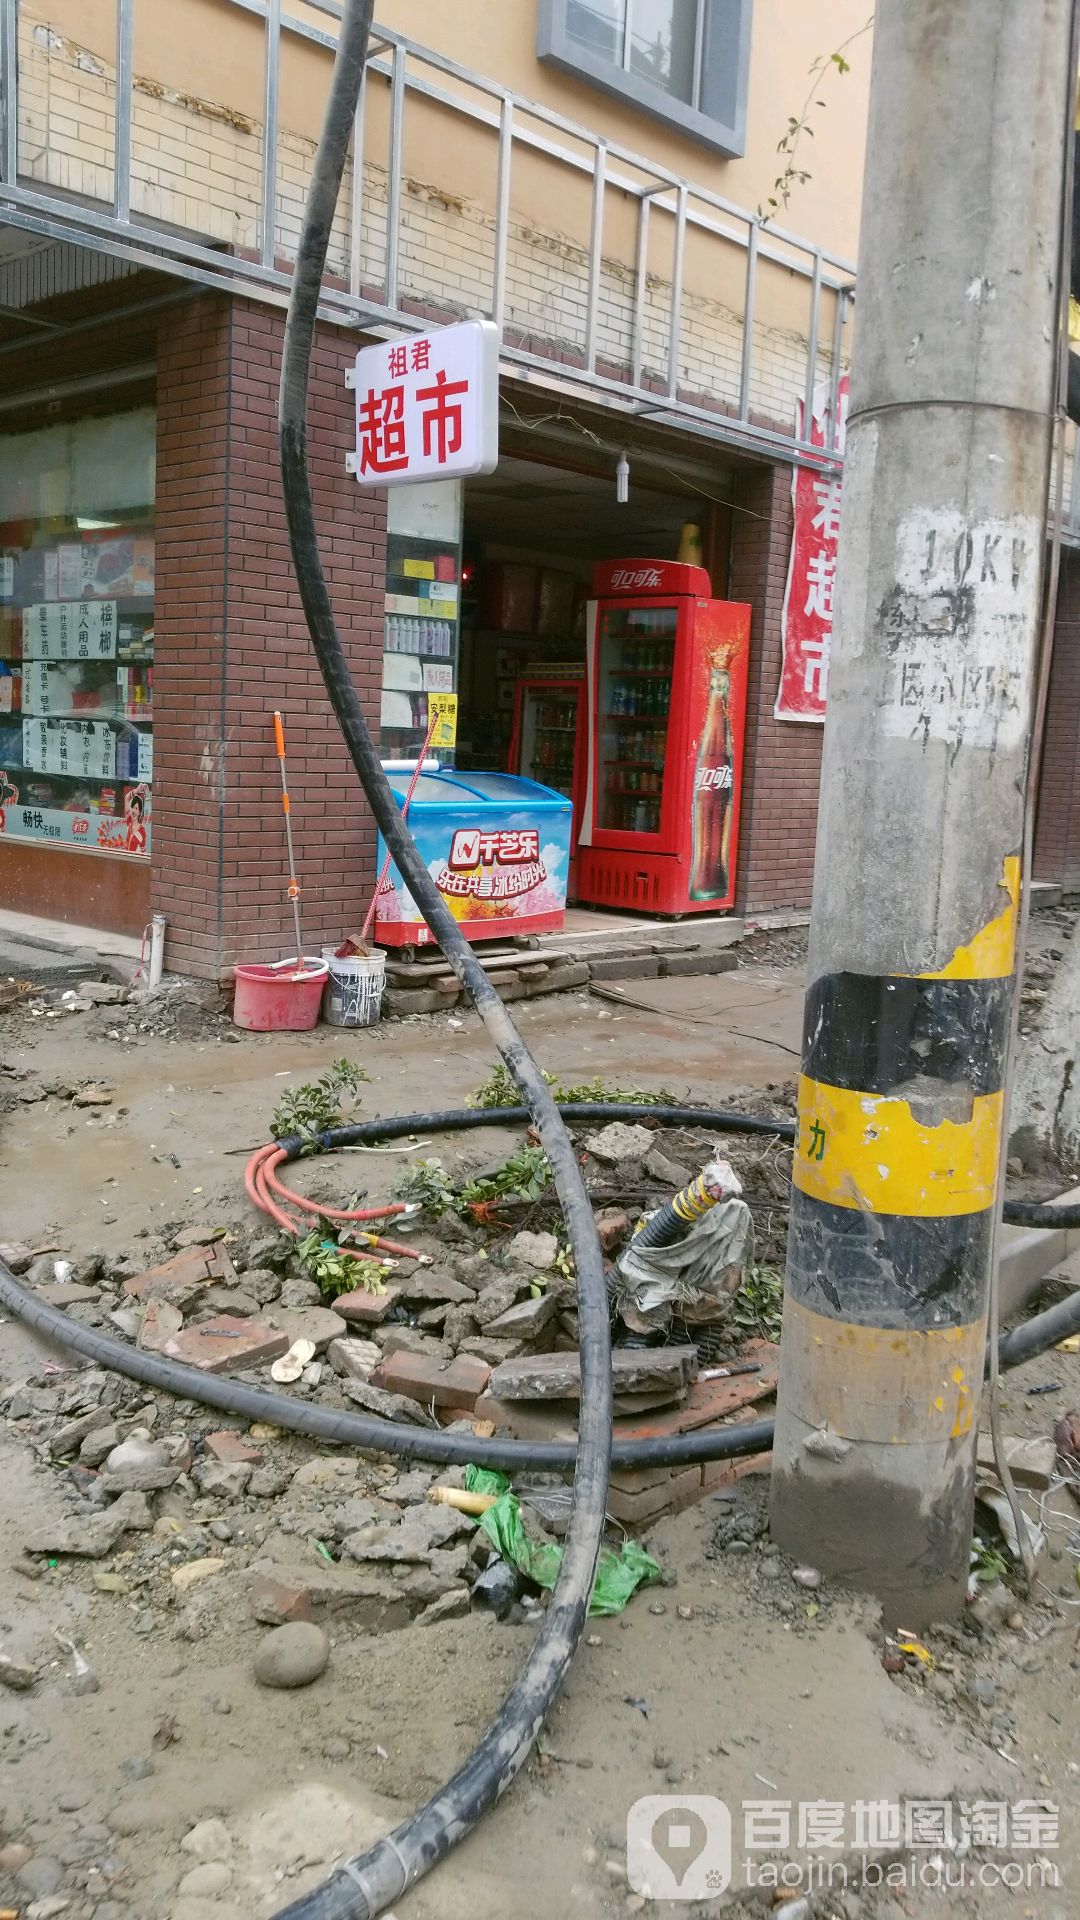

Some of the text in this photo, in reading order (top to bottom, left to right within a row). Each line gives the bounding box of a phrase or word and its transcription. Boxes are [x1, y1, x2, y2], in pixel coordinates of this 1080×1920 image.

[388, 339, 431, 379] 祖君
[359, 369, 469, 476] 超市
[610, 567, 664, 590] 可口可乐
[78, 603, 89, 657] 成人用品
[99, 603, 113, 654] 槟榔
[694, 764, 733, 792] 可口可乐
[23, 809, 44, 829] 畅快
[807, 1118, 827, 1160] 力
